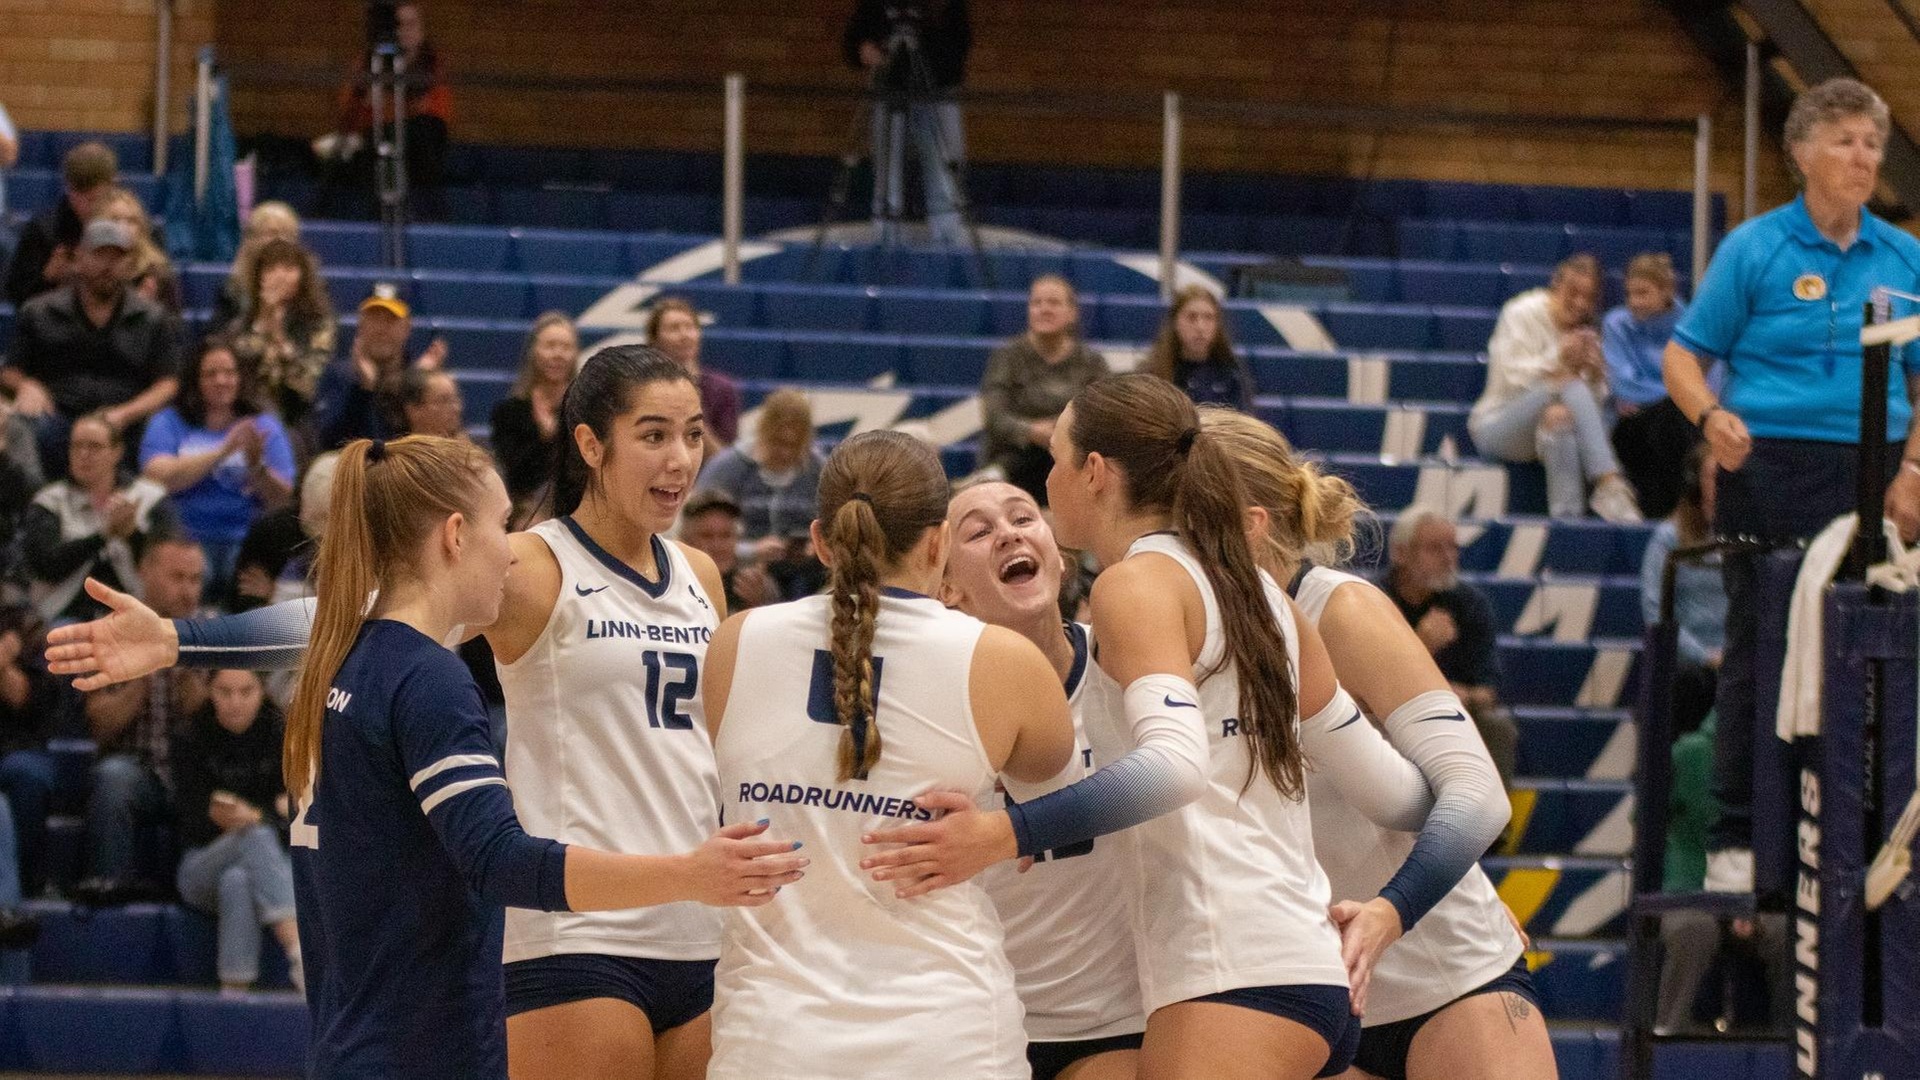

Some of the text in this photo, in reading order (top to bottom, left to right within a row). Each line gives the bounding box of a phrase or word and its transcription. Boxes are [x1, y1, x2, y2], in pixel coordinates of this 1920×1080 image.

[586, 619, 714, 645] LINN-BENTO
[641, 650, 698, 730] 12
[739, 782, 932, 822] ROADRUNNERS
